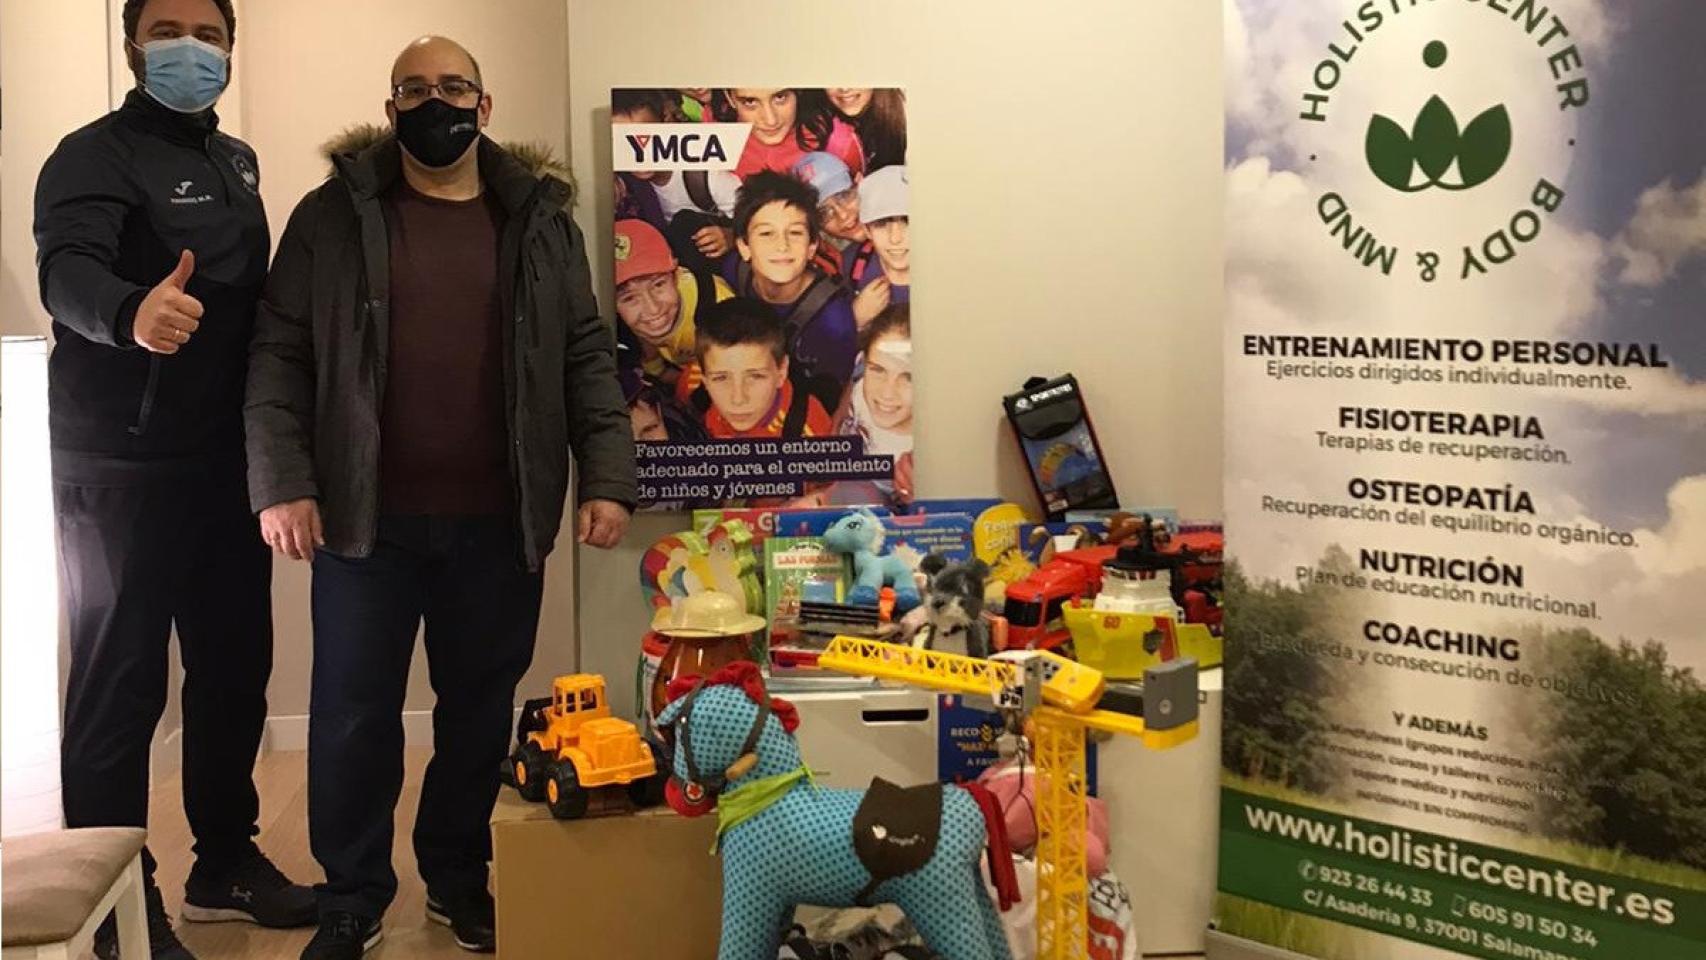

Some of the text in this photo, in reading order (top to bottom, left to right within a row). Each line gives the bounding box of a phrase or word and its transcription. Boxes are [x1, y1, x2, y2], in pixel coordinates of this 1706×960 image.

[1300, 0, 1589, 122] HOLIST ENTER
[626, 133, 727, 164] YMCA
[1317, 178, 1565, 283] BODY & MIND
[1243, 335, 1669, 368] ENTRENAMIENTO PERSONAL
[1266, 360, 1633, 391] Ejercicios dirigidos individualmente.
[1339, 407, 1545, 440] FISIOTERAPIA
[635, 440, 852, 458] Favorecemos un entorno
[1316, 431, 1571, 465] Terapias de recuperación.
[636, 457, 892, 480] adecuado para el crecimiento
[637, 480, 796, 500] de niños y jóvenes
[1348, 478, 1535, 514] OSTEOPATÍA
[1261, 496, 1640, 548] Recuperación del equilibrio orgánico.
[1360, 548, 1524, 587] NUTRICIÓN
[1296, 566, 1603, 620] Plan de educación nutricional.
[1363, 619, 1520, 661] COACHING
[1357, 647, 1371, 666] y
[1373, 649, 1502, 684] consecución
[1506, 668, 1534, 688] de
[1391, 711, 1489, 741] Y ADEMÁS
[1431, 764, 1441, 777] y
[1245, 804, 1676, 925] www.holisticcenter.es
[1303, 888, 1322, 908] C/
[1424, 917, 1478, 945] 37001
[1482, 932, 1579, 960] Salaman
[1319, 865, 1599, 949] 923 26 44 33 605 91 50 34
